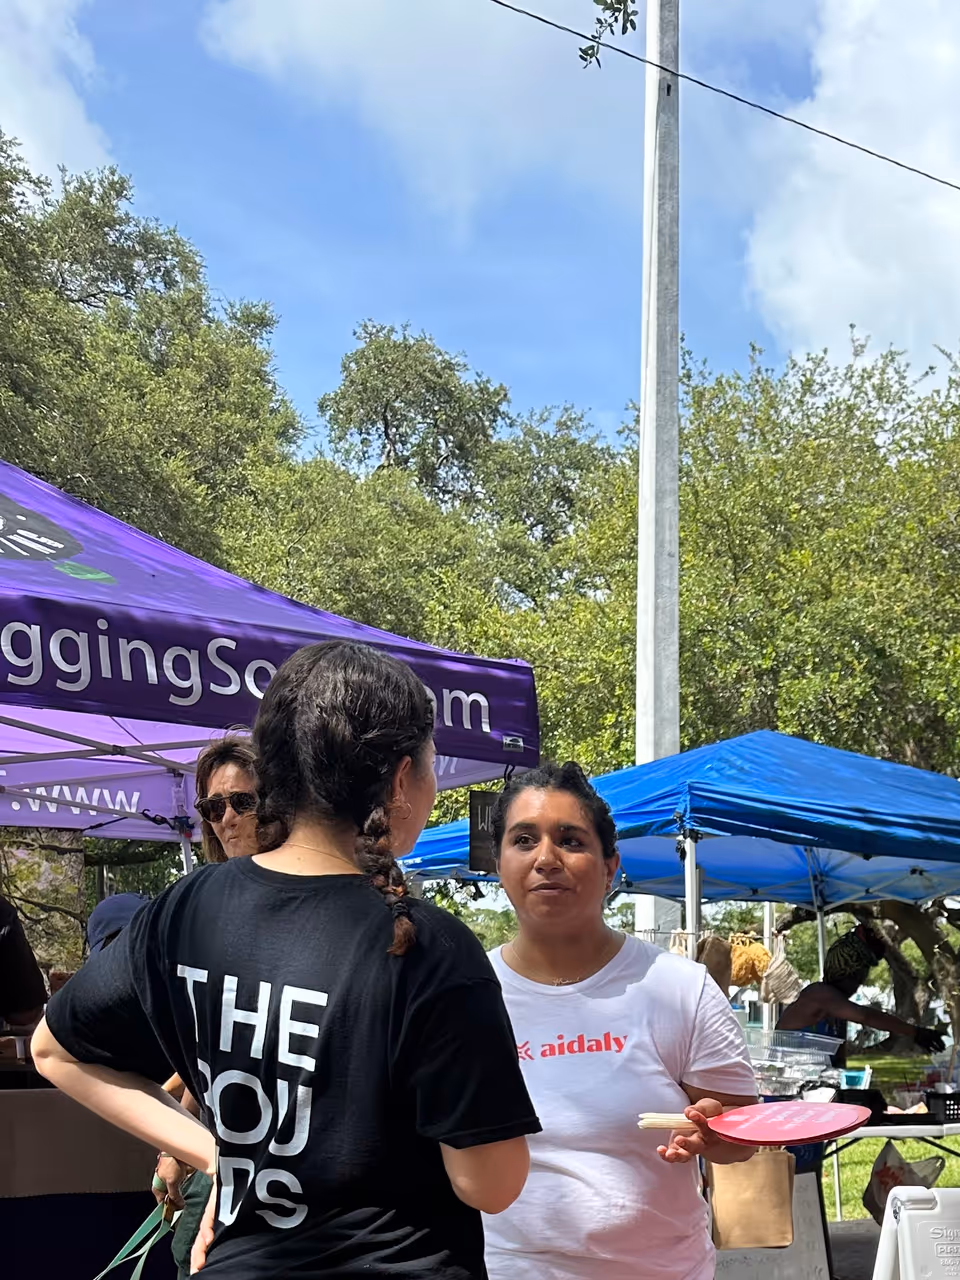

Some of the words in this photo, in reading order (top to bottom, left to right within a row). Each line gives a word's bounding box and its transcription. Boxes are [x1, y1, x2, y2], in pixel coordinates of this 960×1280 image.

[177, 963, 329, 1073] THE
[540, 1031, 628, 1058] aidaly
[215, 1145, 309, 1229] DS
